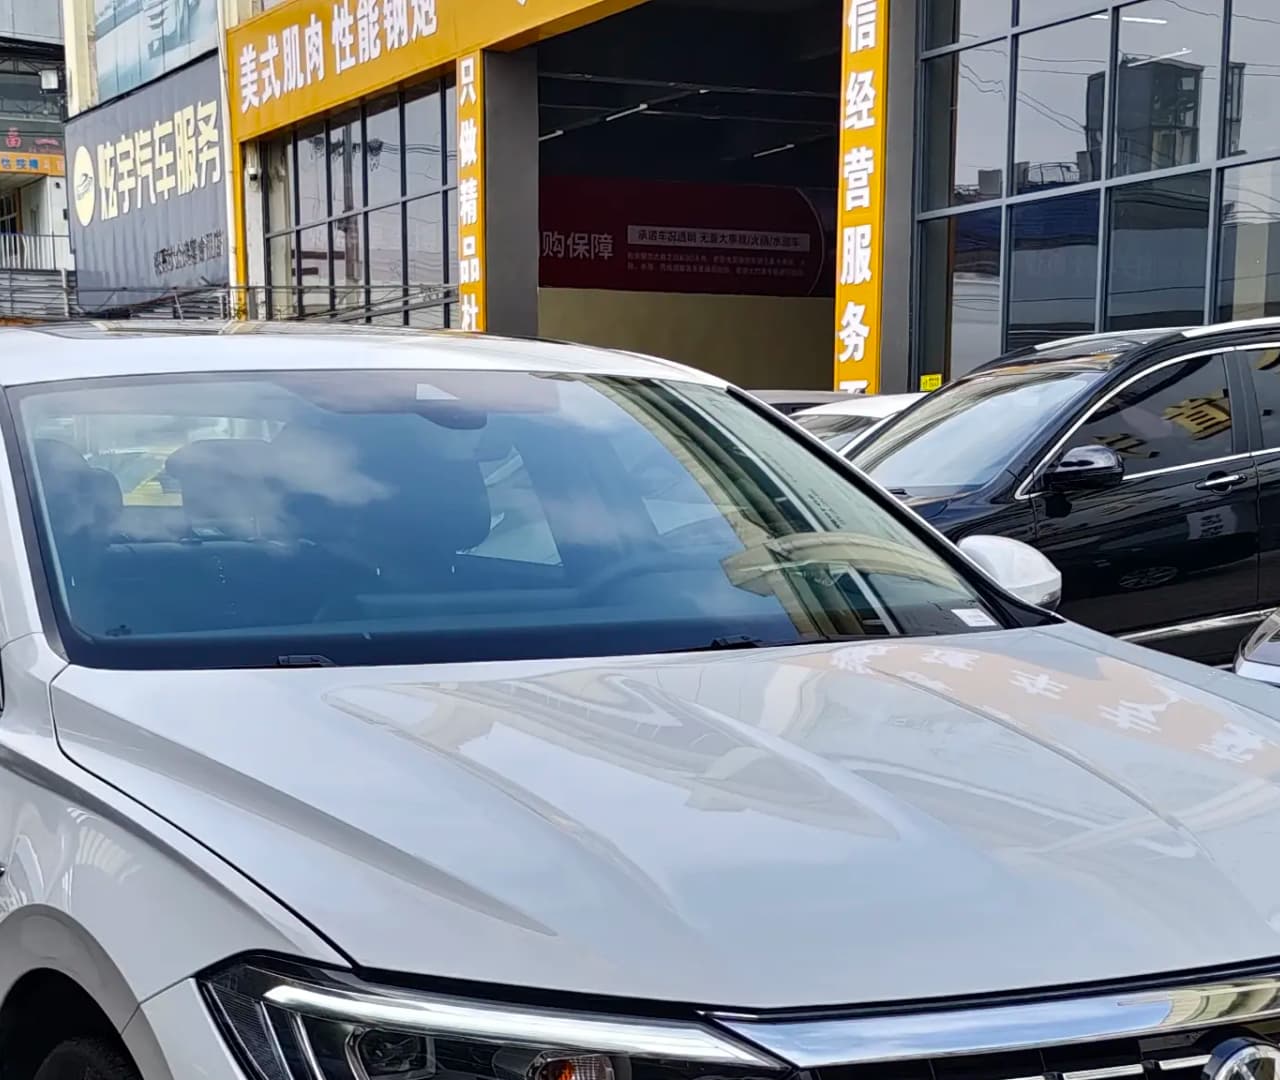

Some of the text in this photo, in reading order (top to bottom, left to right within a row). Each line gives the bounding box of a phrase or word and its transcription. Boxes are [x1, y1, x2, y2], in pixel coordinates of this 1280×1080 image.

[240, 13, 326, 114] 美式肌肉
[542, 231, 614, 260] 购保障
[838, 0, 877, 394] 信经营服务
